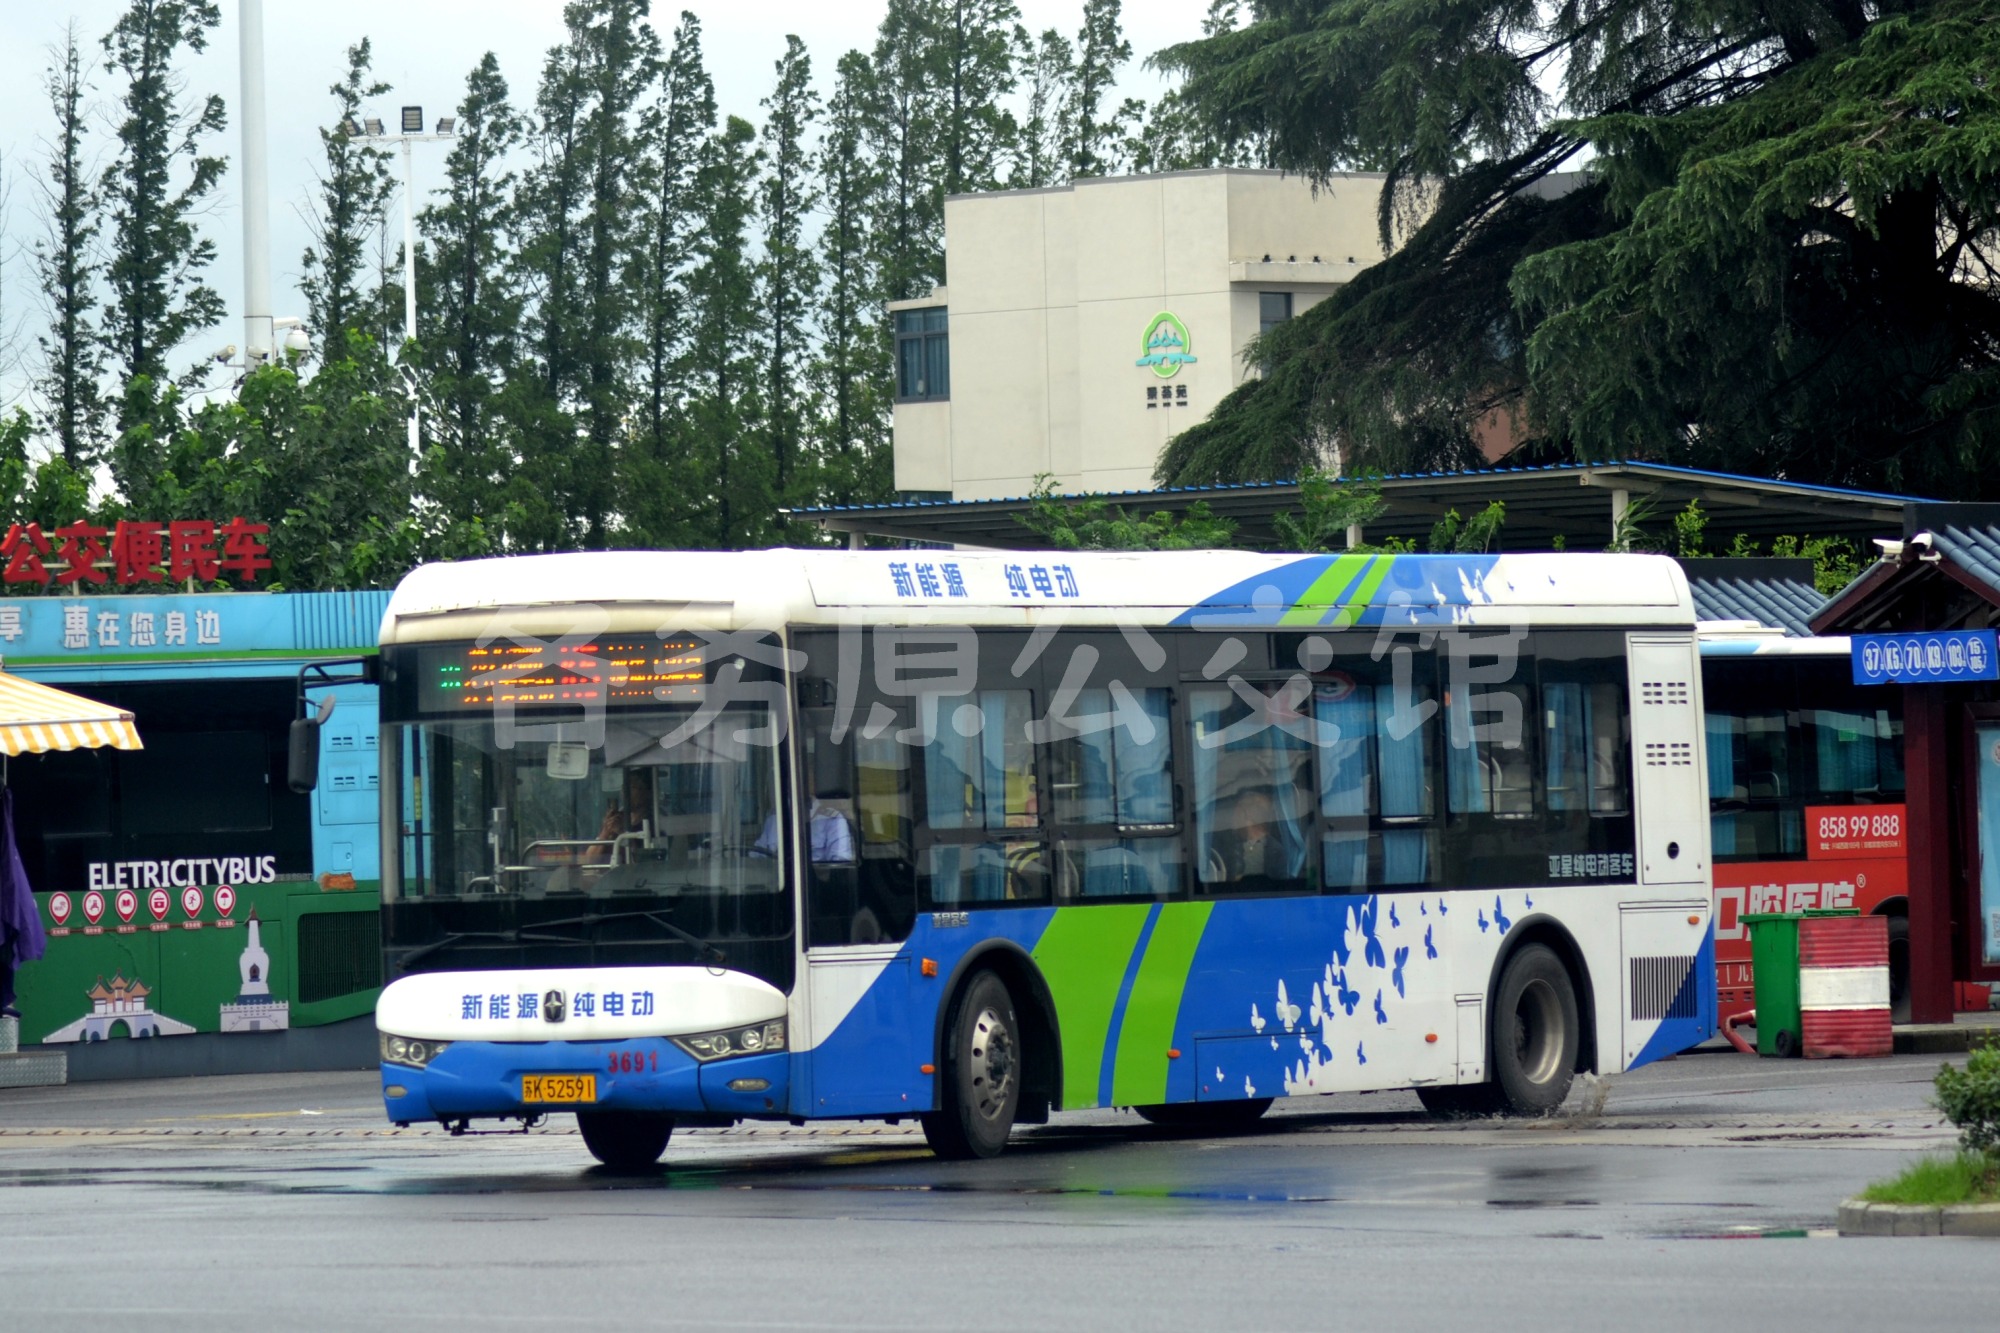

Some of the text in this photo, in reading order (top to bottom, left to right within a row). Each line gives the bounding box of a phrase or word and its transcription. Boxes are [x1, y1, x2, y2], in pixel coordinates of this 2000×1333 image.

[1, 517, 272, 585] 公交便民车
[888, 561, 1080, 598] 新能源 纯电动
[64, 605, 220, 648] 惠在您身边
[1819, 814, 1899, 839] 858 99 888
[89, 856, 276, 890] ELETRICITYBUS
[1548, 853, 1634, 878] 亚星纯电动客车
[461, 991, 655, 1020] 新能源 纯电动
[608, 1051, 658, 1074] 3691
